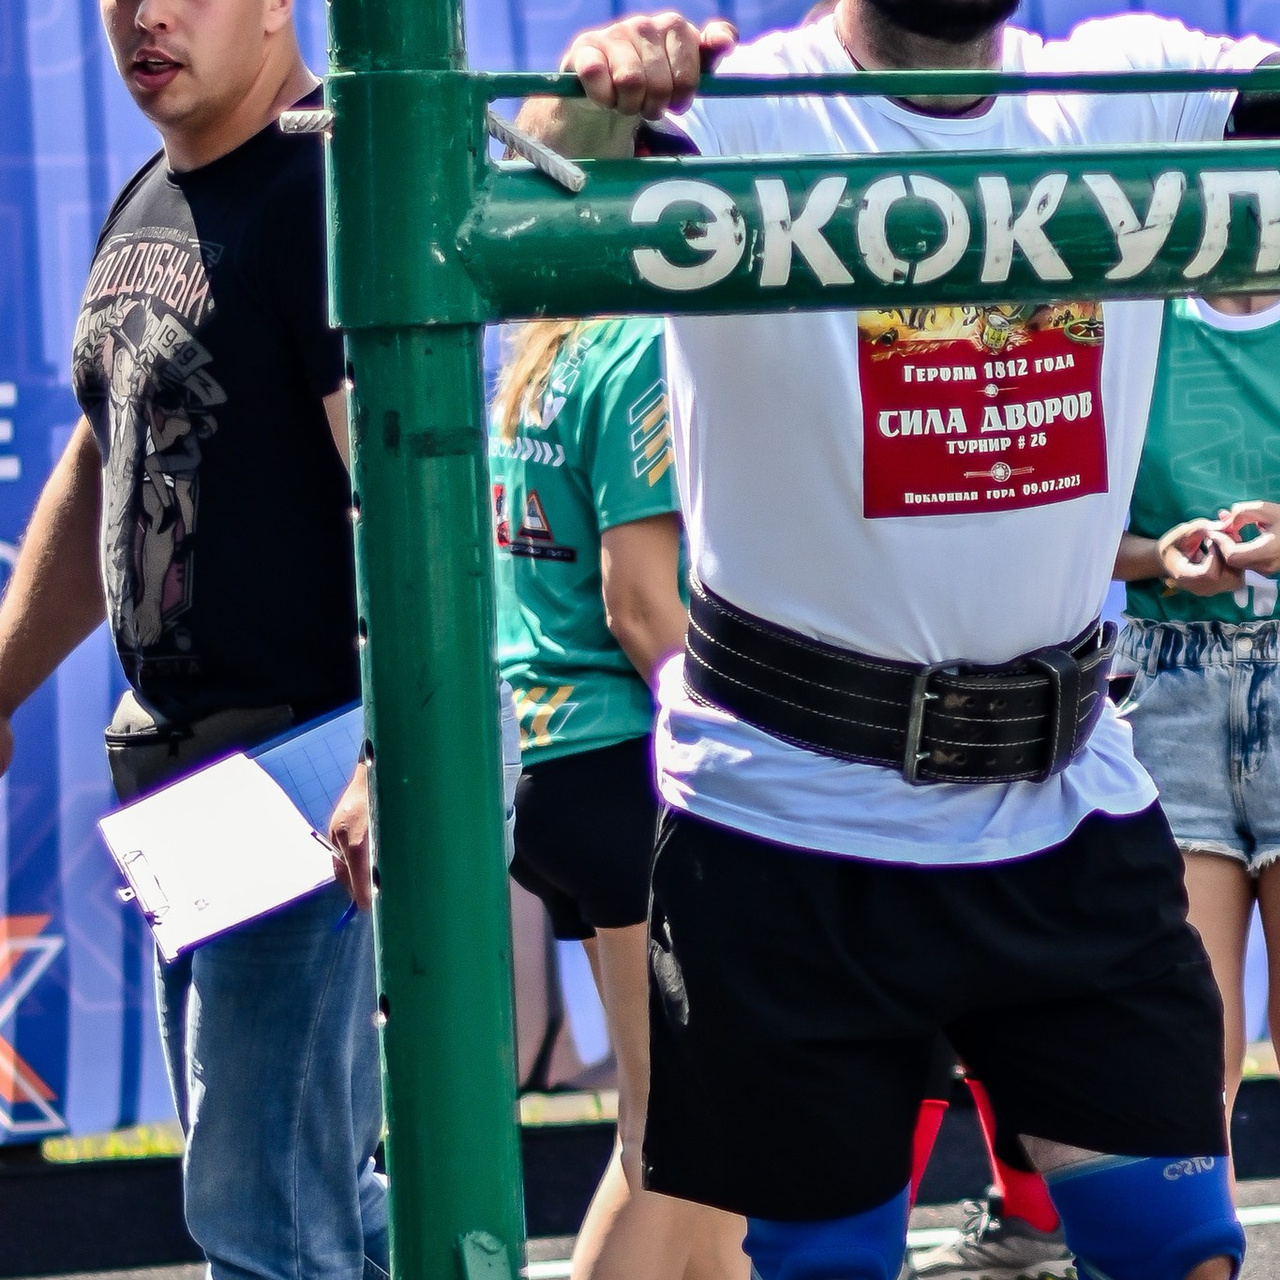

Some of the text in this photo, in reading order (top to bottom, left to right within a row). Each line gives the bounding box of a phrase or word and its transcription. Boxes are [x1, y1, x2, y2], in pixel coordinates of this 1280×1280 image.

[157, 324, 198, 365] 1949
[983, 359, 1028, 379] 1812
[878, 391, 1093, 438] СИЛА ДВОРОВ
[946, 432, 1047, 455] ТУРНИР # 26
[1022, 474, 1081, 496] 09.07.2023
